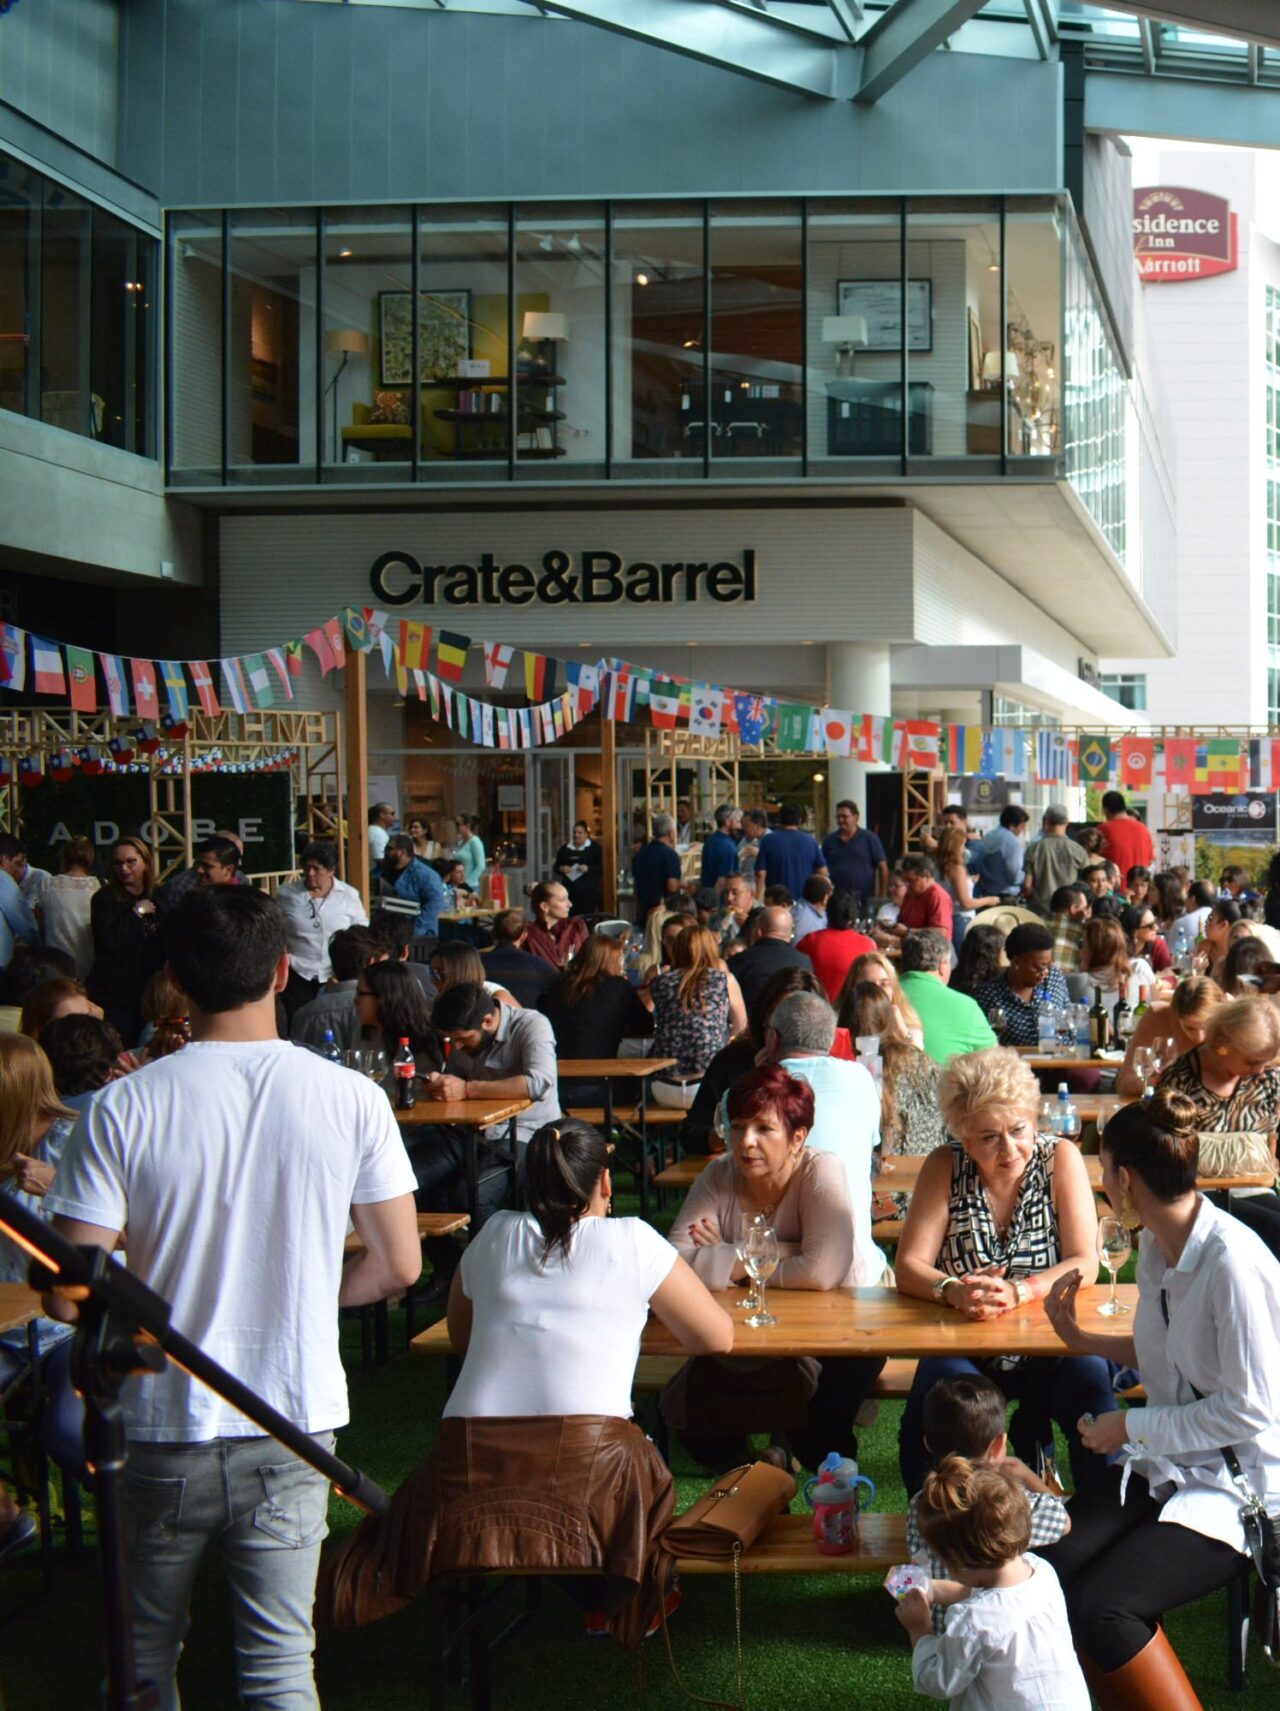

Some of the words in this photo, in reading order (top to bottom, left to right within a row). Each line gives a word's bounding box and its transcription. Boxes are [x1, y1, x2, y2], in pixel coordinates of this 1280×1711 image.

[1148, 235, 1175, 248] Inn
[369, 549, 756, 606] Crate&Barrel
[1203, 802, 1251, 815] Oceanic
[48, 817, 265, 846] ADOBE
